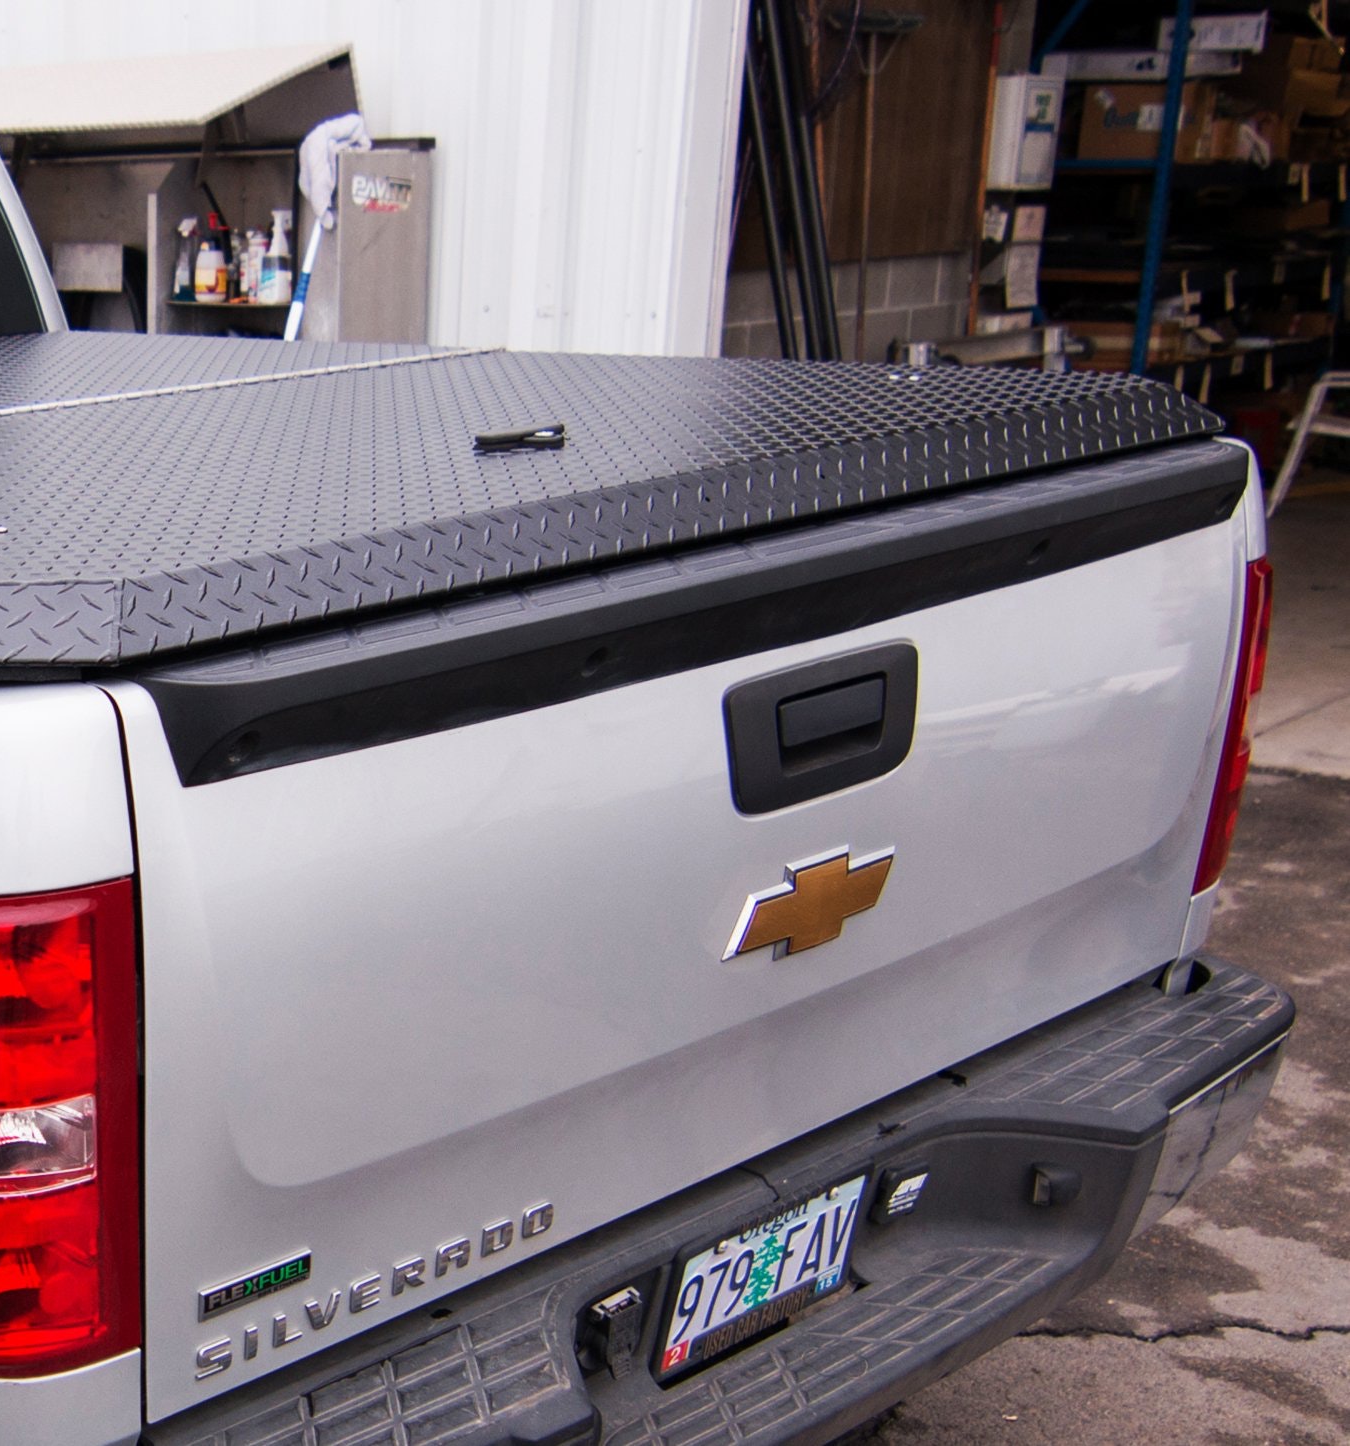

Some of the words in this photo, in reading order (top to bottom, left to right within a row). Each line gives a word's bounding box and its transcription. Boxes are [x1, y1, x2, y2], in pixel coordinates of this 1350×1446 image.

[195, 1202, 554, 1381] SILVERADO
[207, 1260, 309, 1310] FLEXFUEL
[672, 1249, 755, 1345] 979
[772, 1197, 858, 1294] FAV
[668, 1346, 682, 1367] 2
